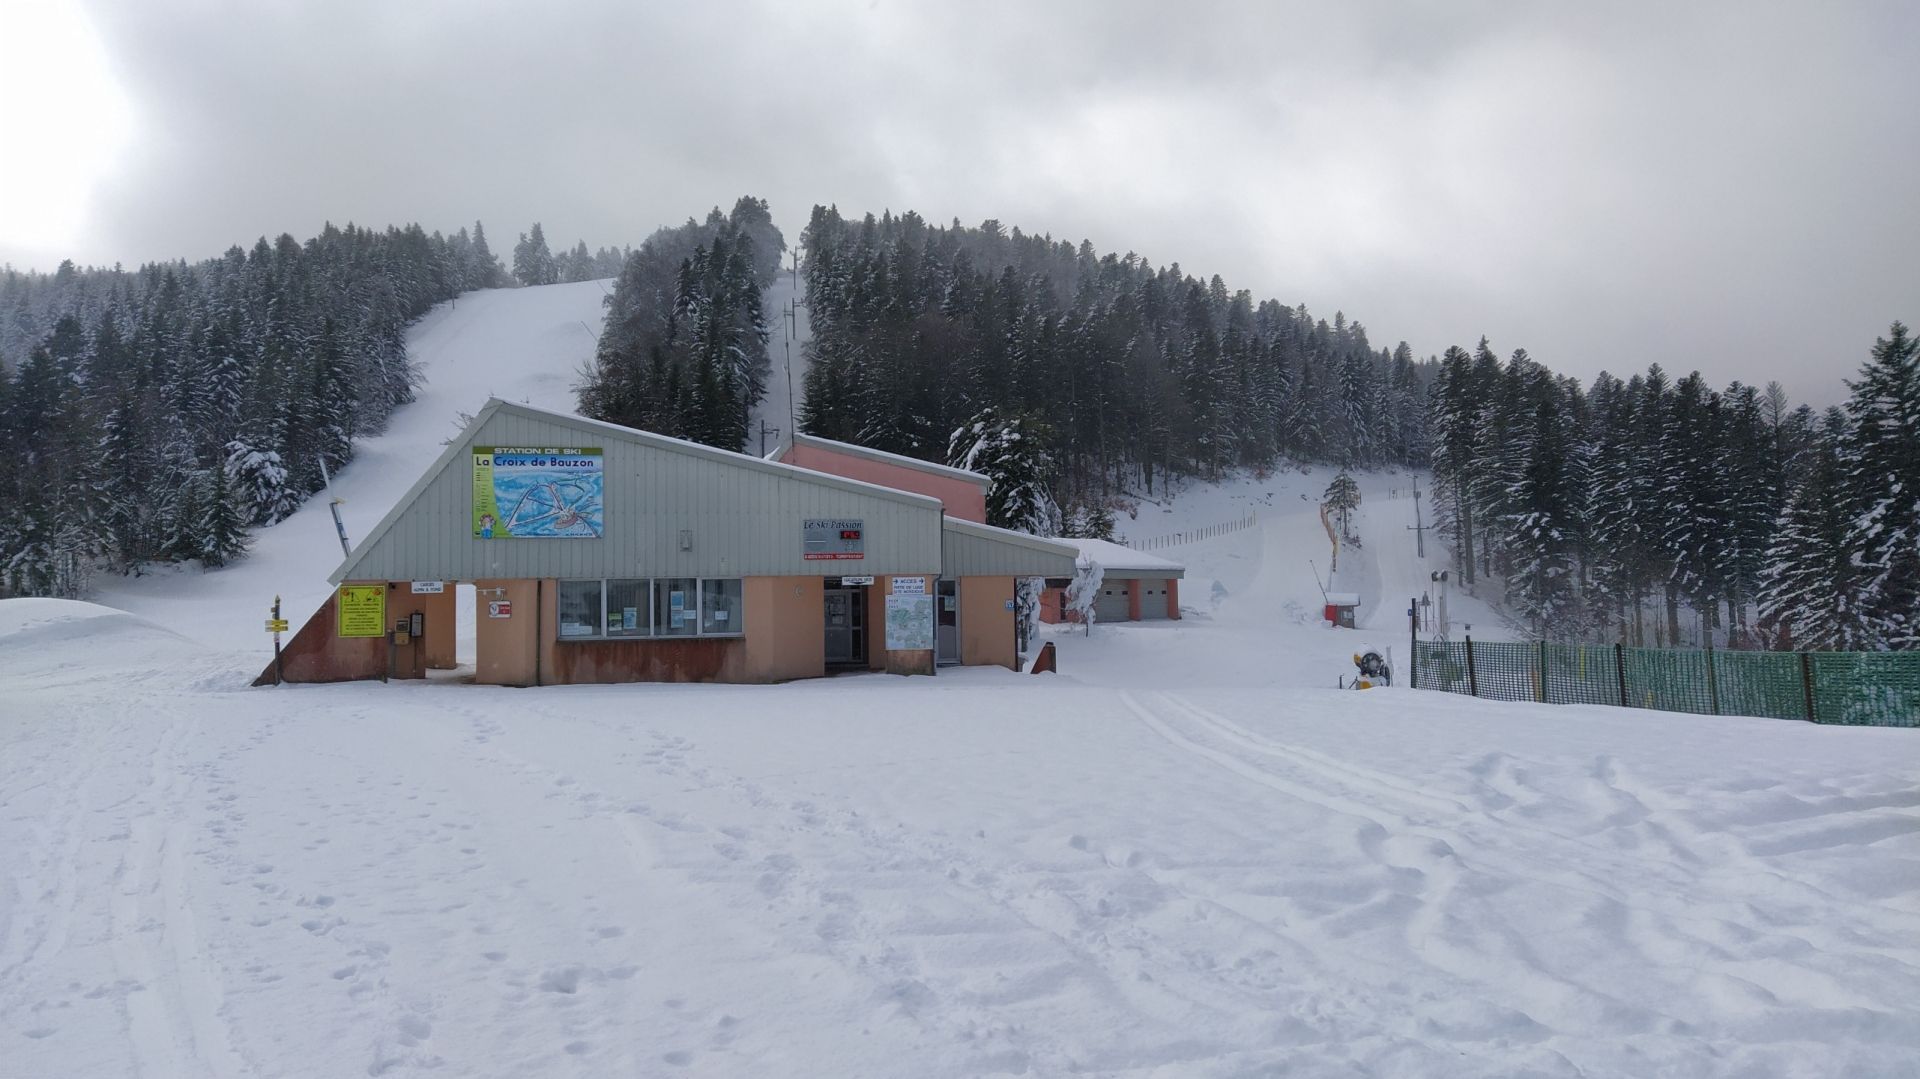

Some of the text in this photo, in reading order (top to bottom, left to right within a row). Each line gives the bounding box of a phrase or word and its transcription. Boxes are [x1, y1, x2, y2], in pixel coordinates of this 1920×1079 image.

[494, 447, 542, 455] STATION
[476, 456, 594, 467] La Croix de Bauzon
